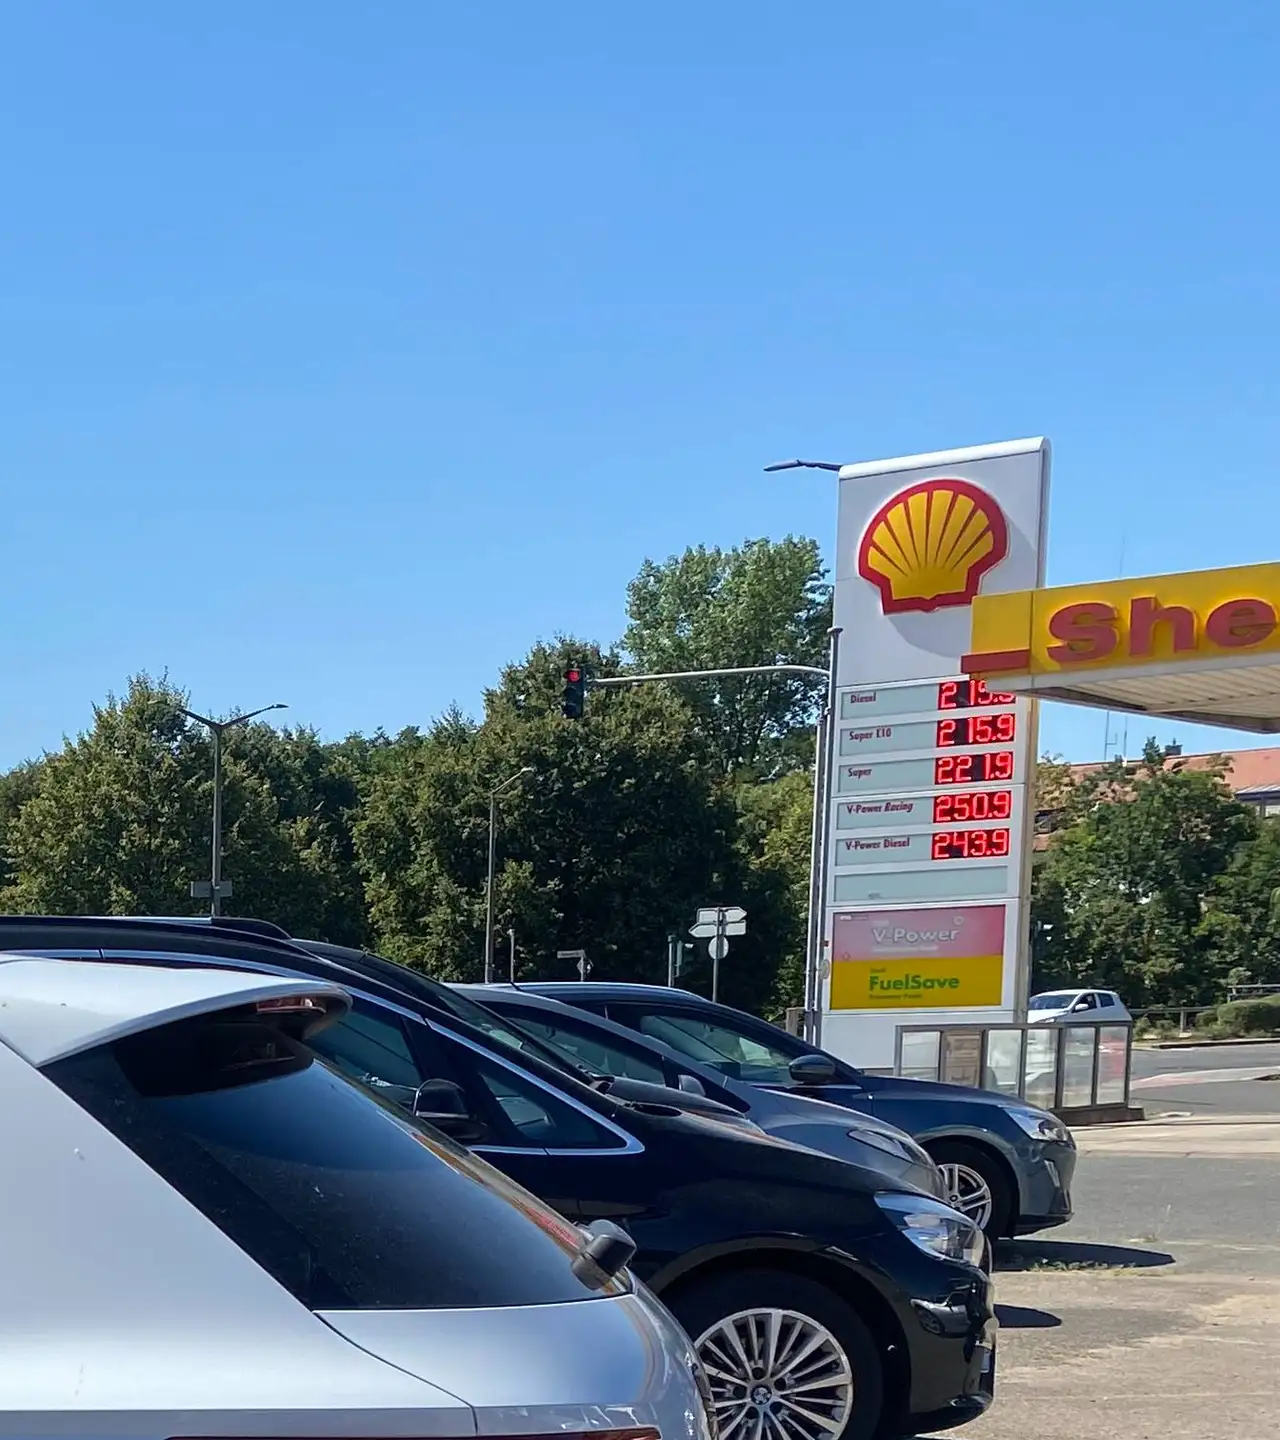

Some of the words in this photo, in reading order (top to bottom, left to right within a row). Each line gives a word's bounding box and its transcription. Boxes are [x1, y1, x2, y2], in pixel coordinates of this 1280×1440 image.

[1046, 596, 1277, 664] She
[850, 692, 877, 703] Diesel
[849, 730, 873, 742] Super
[876, 727, 892, 739] E10
[938, 714, 1015, 746] 215.9
[847, 767, 872, 779] Super
[936, 752, 1013, 784] 221.9
[846, 803, 882, 815] V-Power
[884, 800, 914, 814] Racing
[934, 791, 1011, 823] 250.9
[845, 840, 881, 851] V-Power
[883, 836, 910, 849] Diesel
[933, 829, 1009, 860] 243.9
[871, 925, 960, 944] V-Power
[868, 973, 961, 992] FuelSave
